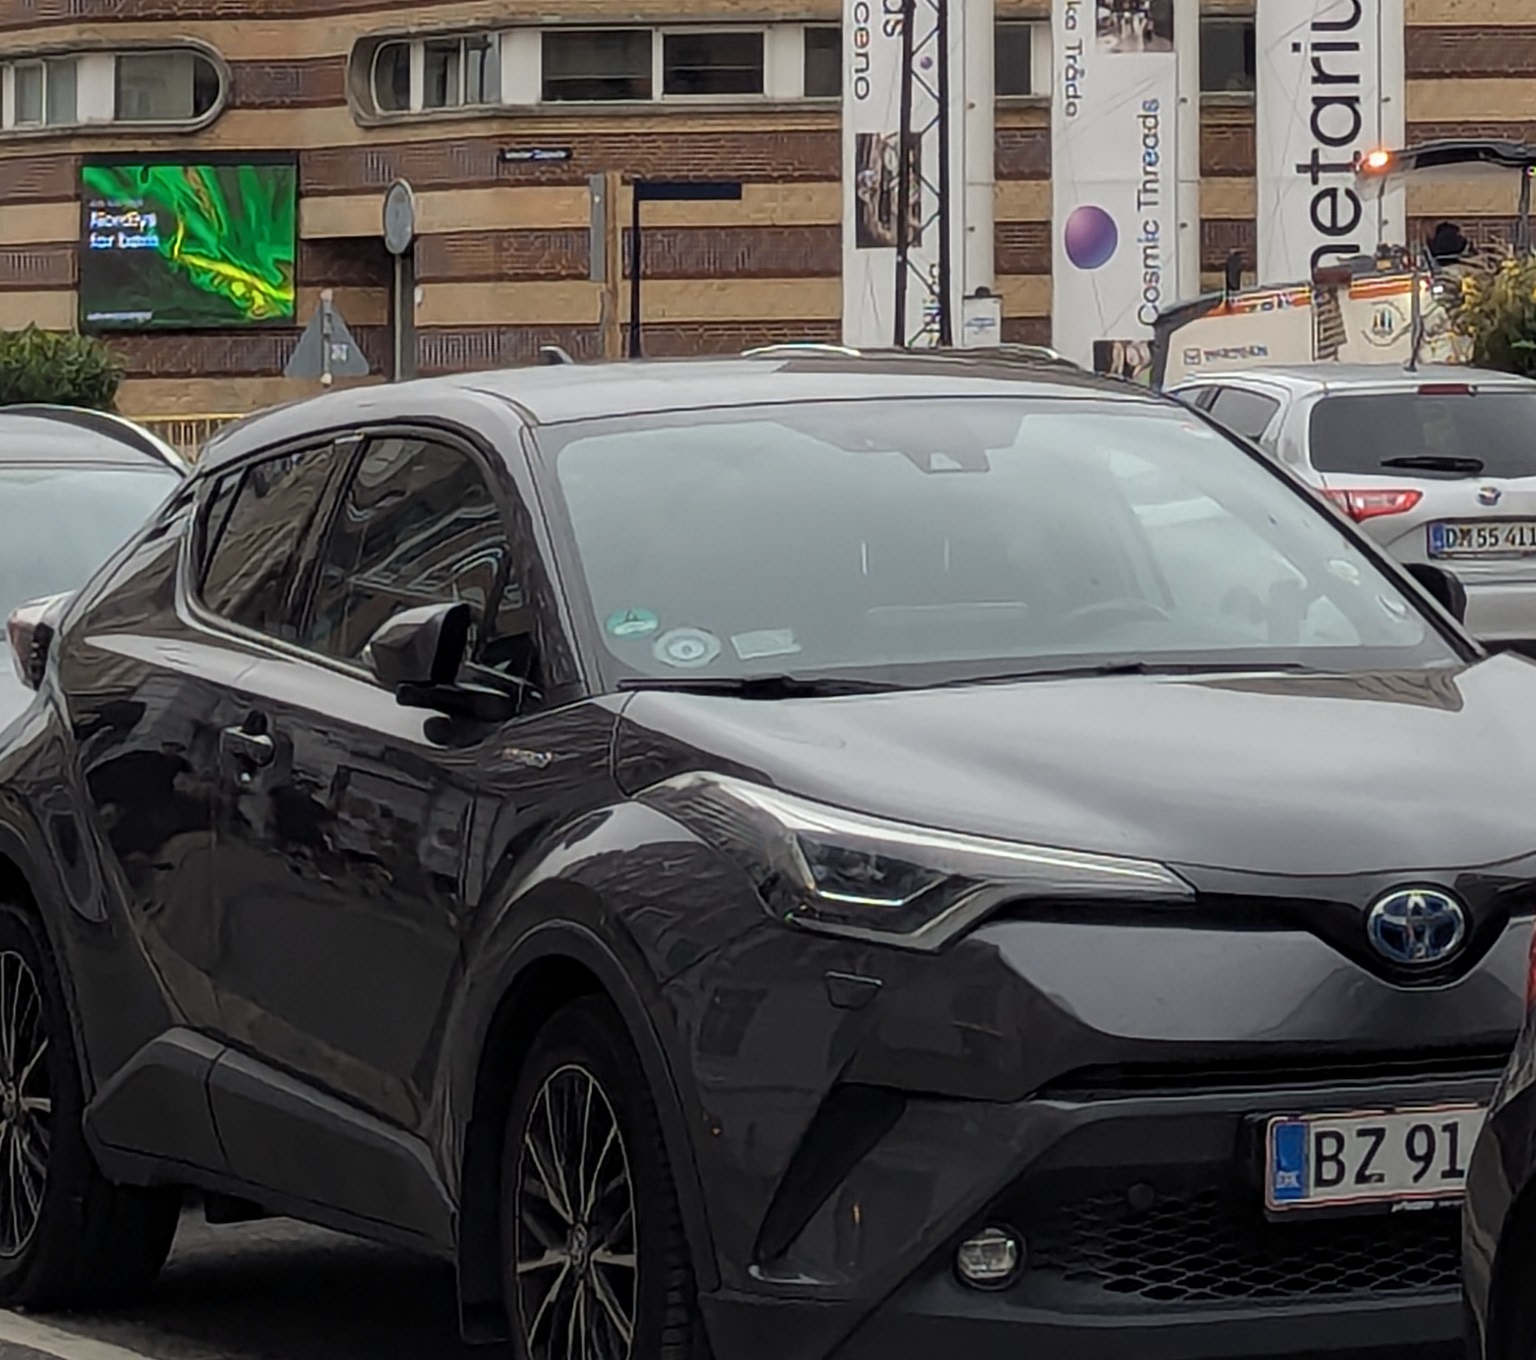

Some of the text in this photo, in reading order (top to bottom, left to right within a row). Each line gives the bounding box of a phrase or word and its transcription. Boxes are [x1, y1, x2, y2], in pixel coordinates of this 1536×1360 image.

[1137, 98, 1161, 327] Cosmic Threads
[1476, 527, 1499, 548] 55
[1313, 1120, 1466, 1189] BZ 91
